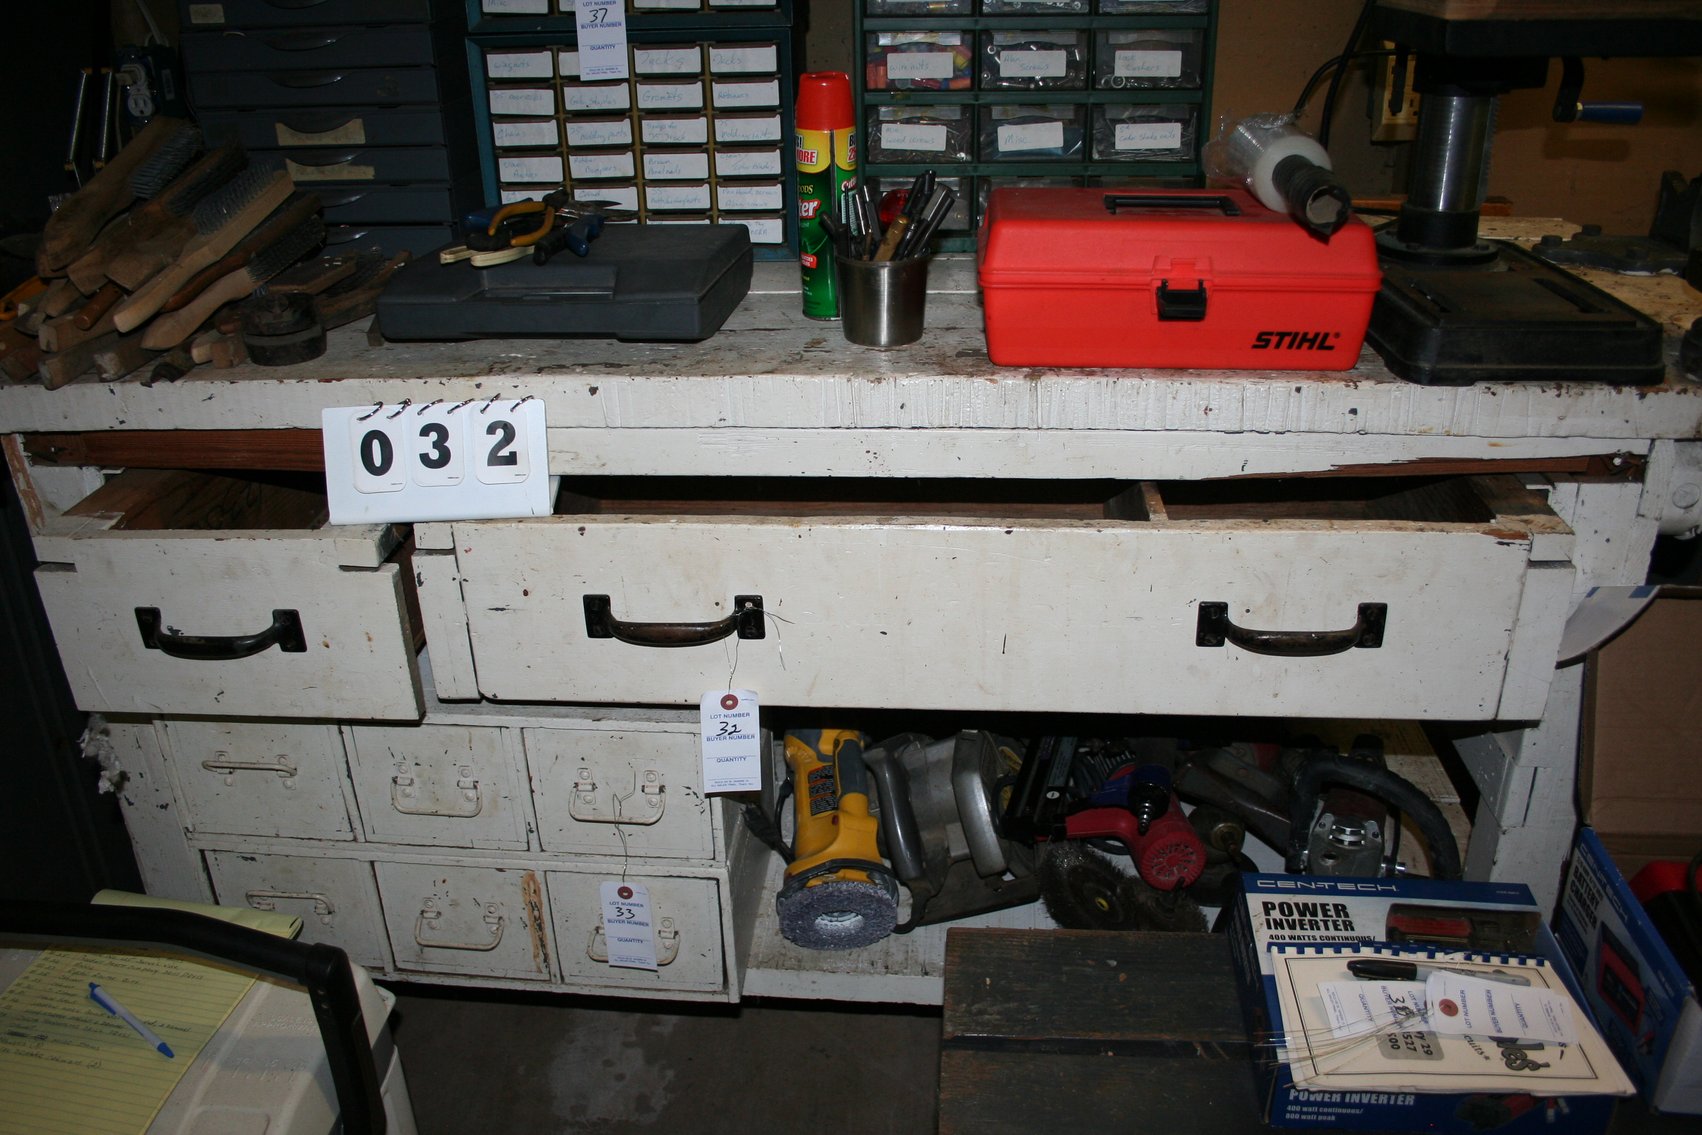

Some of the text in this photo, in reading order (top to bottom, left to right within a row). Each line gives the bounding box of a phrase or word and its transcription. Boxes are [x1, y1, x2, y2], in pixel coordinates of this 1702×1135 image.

[589, 8, 608, 23] 37
[1251, 331, 1335, 351] STIHL
[716, 721, 742, 736] 32
[615, 906, 636, 920] 33
[1262, 900, 1351, 918] POWER
[1265, 918, 1355, 931] INVERTER
[1460, 989, 1472, 1029] LOT NUMBER
[1344, 1093, 1416, 1106] INVERTER
[1301, 1113, 1317, 1121] watt
